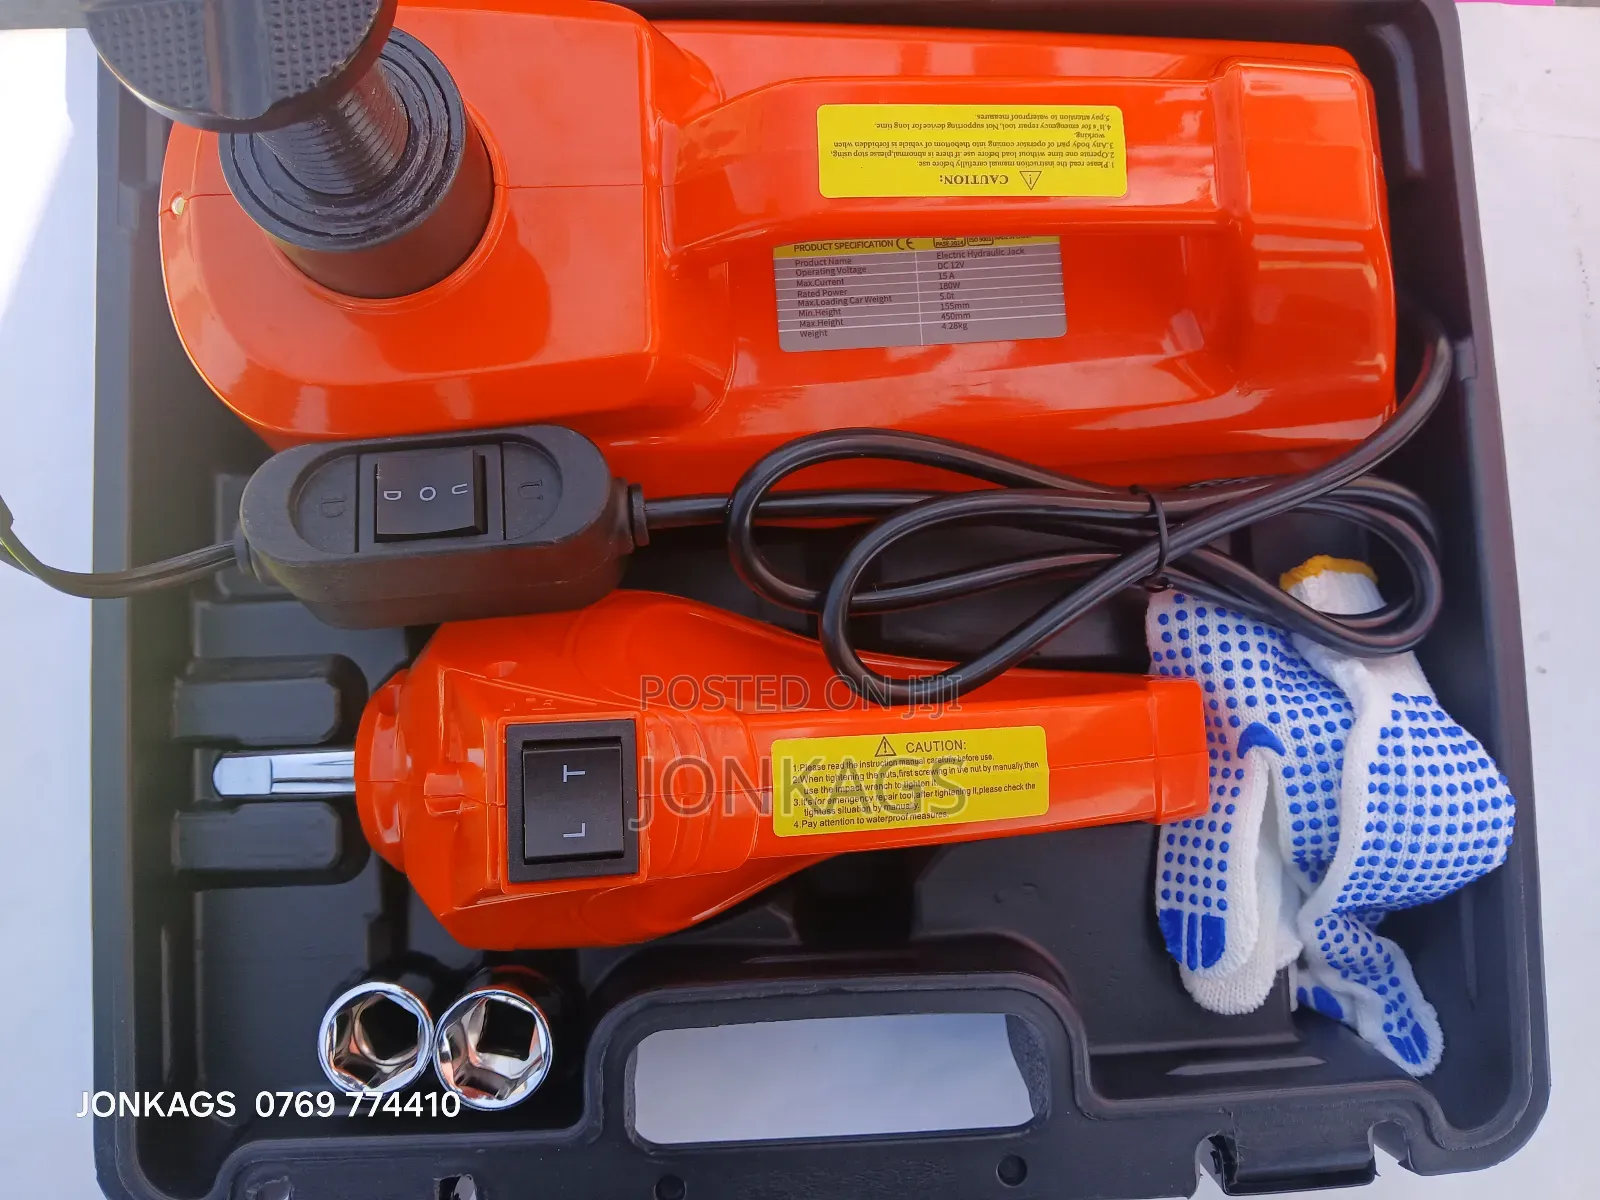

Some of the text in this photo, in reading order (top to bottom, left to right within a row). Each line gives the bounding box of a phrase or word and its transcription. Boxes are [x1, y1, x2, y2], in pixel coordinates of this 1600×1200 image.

[1011, 113, 1048, 121] waterproof
[894, 122, 910, 130] long
[947, 122, 984, 130] supporting
[988, 140, 1014, 148] coming
[956, 160, 987, 168] carefully
[939, 174, 1008, 185] CAUTION:
[794, 243, 833, 252] PRODUCT
[835, 240, 893, 250] SPECIFICATION
[937, 247, 1025, 259] Electric Hydraulic Jack
[795, 259, 827, 267] Product
[938, 262, 948, 270] DC
[796, 266, 866, 276] Operating Voltage
[939, 282, 960, 290] 180W
[798, 290, 820, 298] Rated
[940, 292, 954, 300] 5.0t
[850, 296, 863, 304] Car
[864, 295, 892, 304] Weight
[941, 302, 970, 310] 155mm
[941, 312, 971, 320] 450mm
[942, 322, 968, 330] 4.28kg
[800, 330, 828, 339] Weight
[906, 740, 966, 753] CAUTION:
[828, 762, 845, 770] read
[949, 766, 955, 774] in
[970, 764, 982, 772] nut
[983, 764, 991, 774] by
[821, 785, 833, 794] the
[1004, 784, 1024, 792] check
[1025, 782, 1035, 790] the
[873, 803, 881, 813] by
[884, 802, 919, 811] manuay.
[820, 816, 855, 826] attention
[857, 815, 864, 824] to
[866, 813, 908, 823] waterproof
